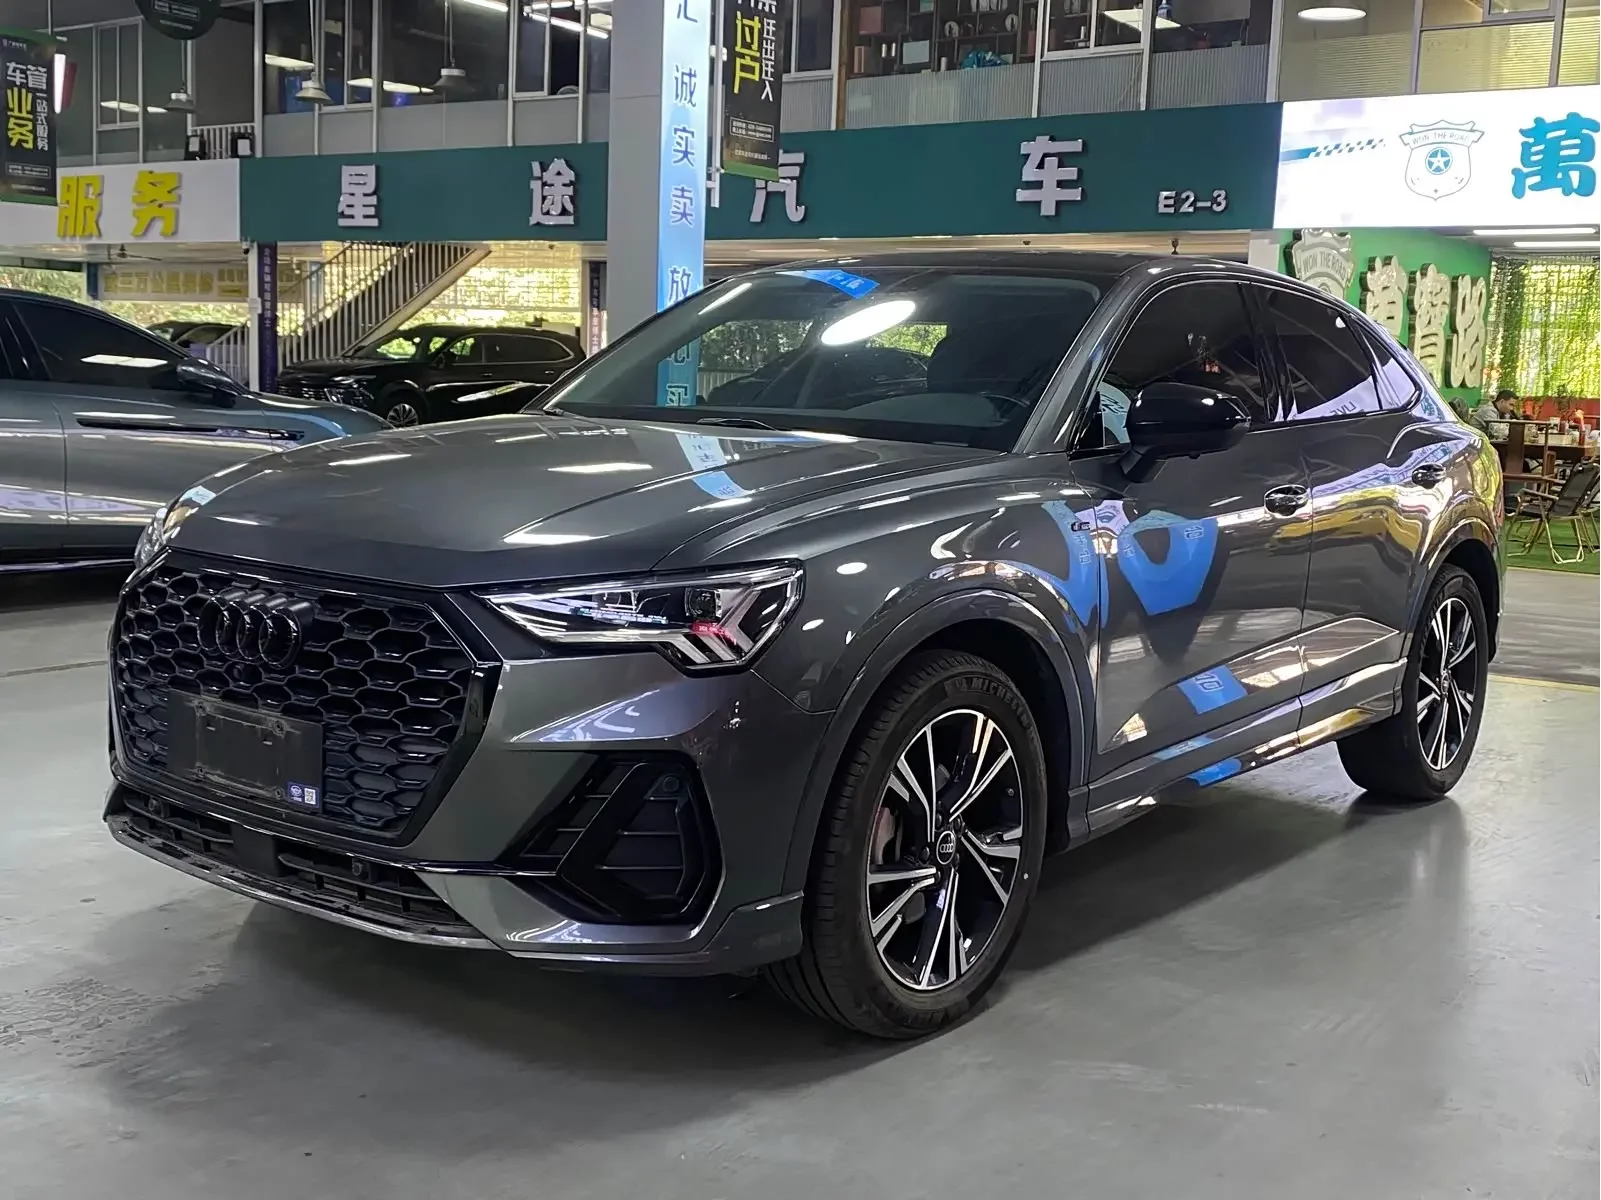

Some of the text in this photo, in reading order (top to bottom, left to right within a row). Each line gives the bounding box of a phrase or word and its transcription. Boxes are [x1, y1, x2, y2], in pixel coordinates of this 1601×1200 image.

[6, 61, 48, 90] 车管
[735, 10, 761, 94] 过户
[761, 17, 776, 102] 迁出迁入
[7, 86, 34, 150] 业务
[671, 65, 697, 226] 诚实卖
[1511, 112, 1601, 199] 萬
[57, 169, 183, 239] 服务
[1157, 189, 1227, 214] E2-3
[1302, 252, 1318, 275] WON
[1319, 251, 1332, 270] THE
